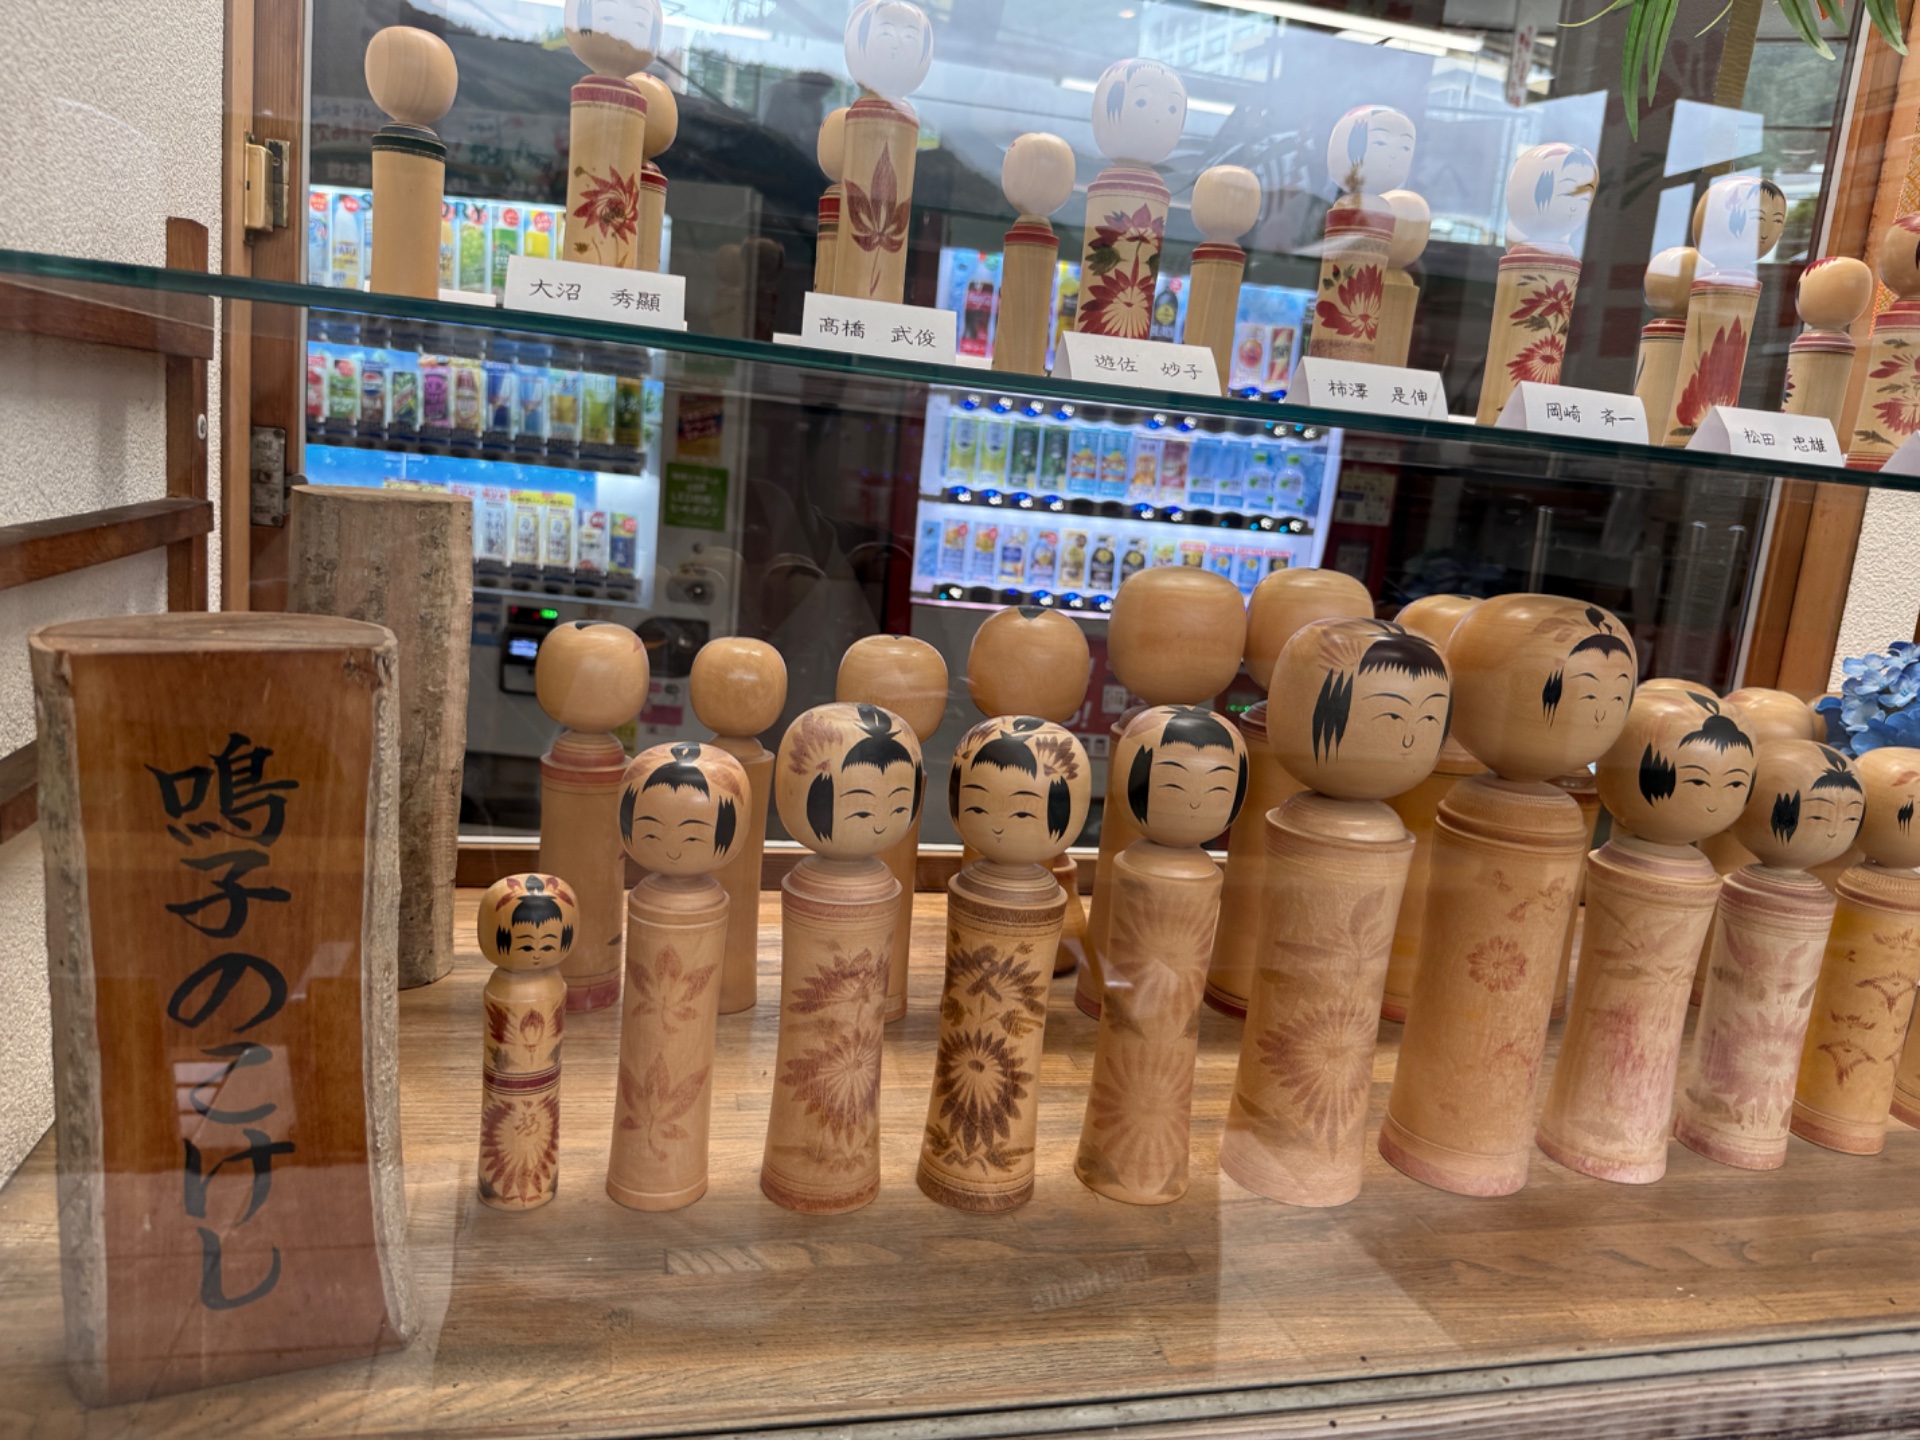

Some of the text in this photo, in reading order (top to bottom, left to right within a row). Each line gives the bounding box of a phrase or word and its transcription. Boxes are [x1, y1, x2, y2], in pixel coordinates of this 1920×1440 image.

[529, 279, 582, 301] 大沼
[891, 325, 936, 348] 武俊
[1094, 354, 1203, 380] 遊佐 妙子
[1328, 379, 1428, 407] 柿澤 是伸
[1546, 402, 1581, 423] 岡崎
[1744, 428, 1827, 453] 松田 忠雄
[144, 731, 299, 1311] 鳴子のこけし
